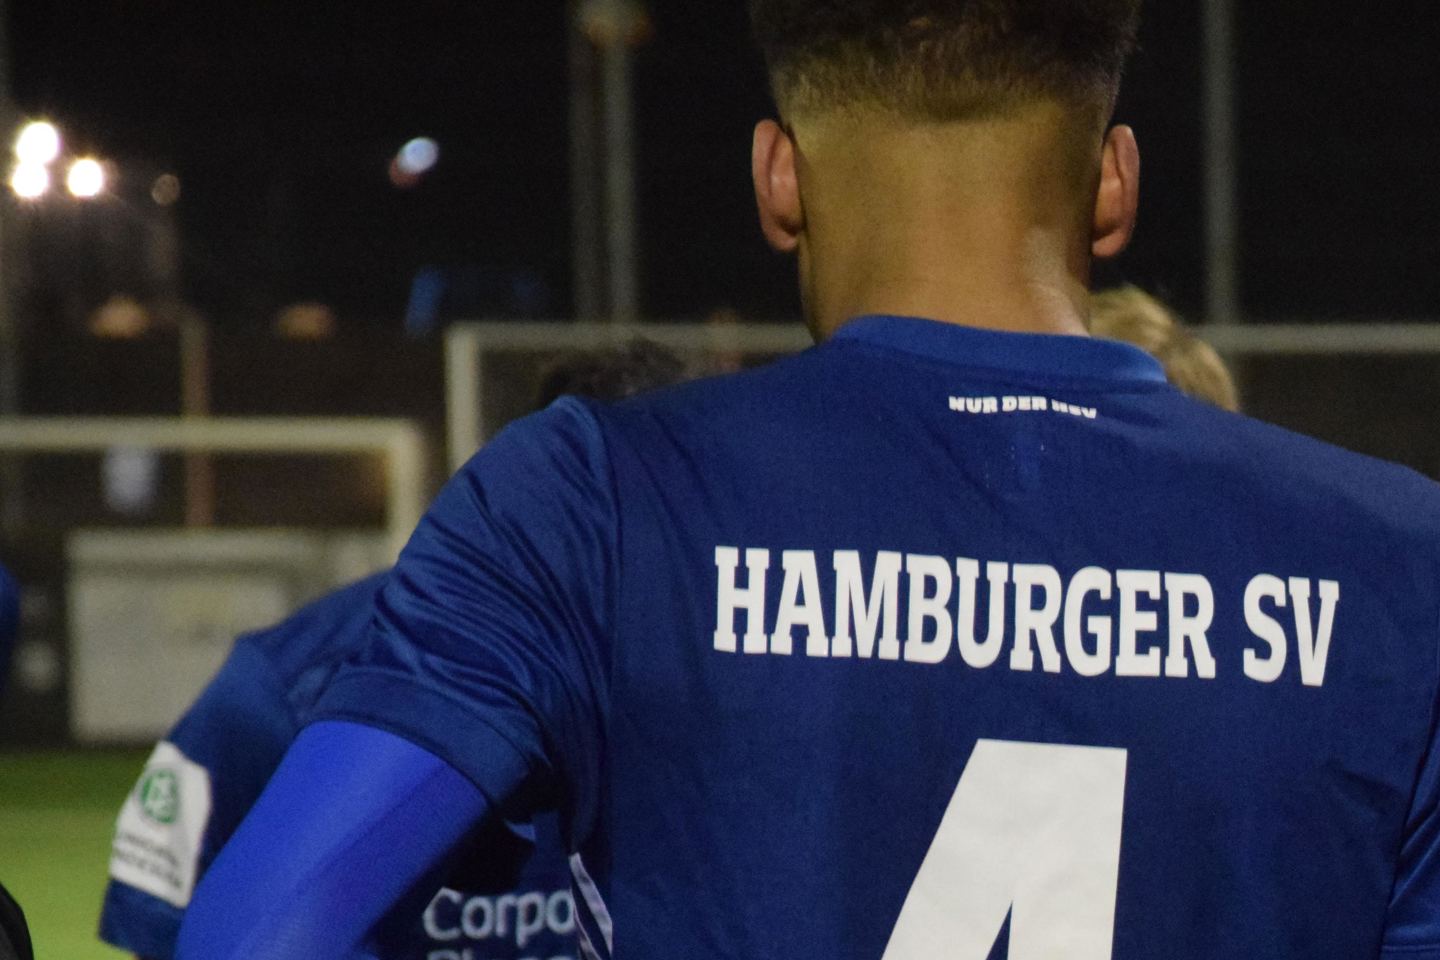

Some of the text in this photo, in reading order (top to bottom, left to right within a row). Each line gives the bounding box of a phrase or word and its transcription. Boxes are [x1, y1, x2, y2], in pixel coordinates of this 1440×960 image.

[948, 396, 998, 414] NUR
[1002, 395, 1048, 412] DER
[713, 545, 1341, 687] HAMBURGER SV
